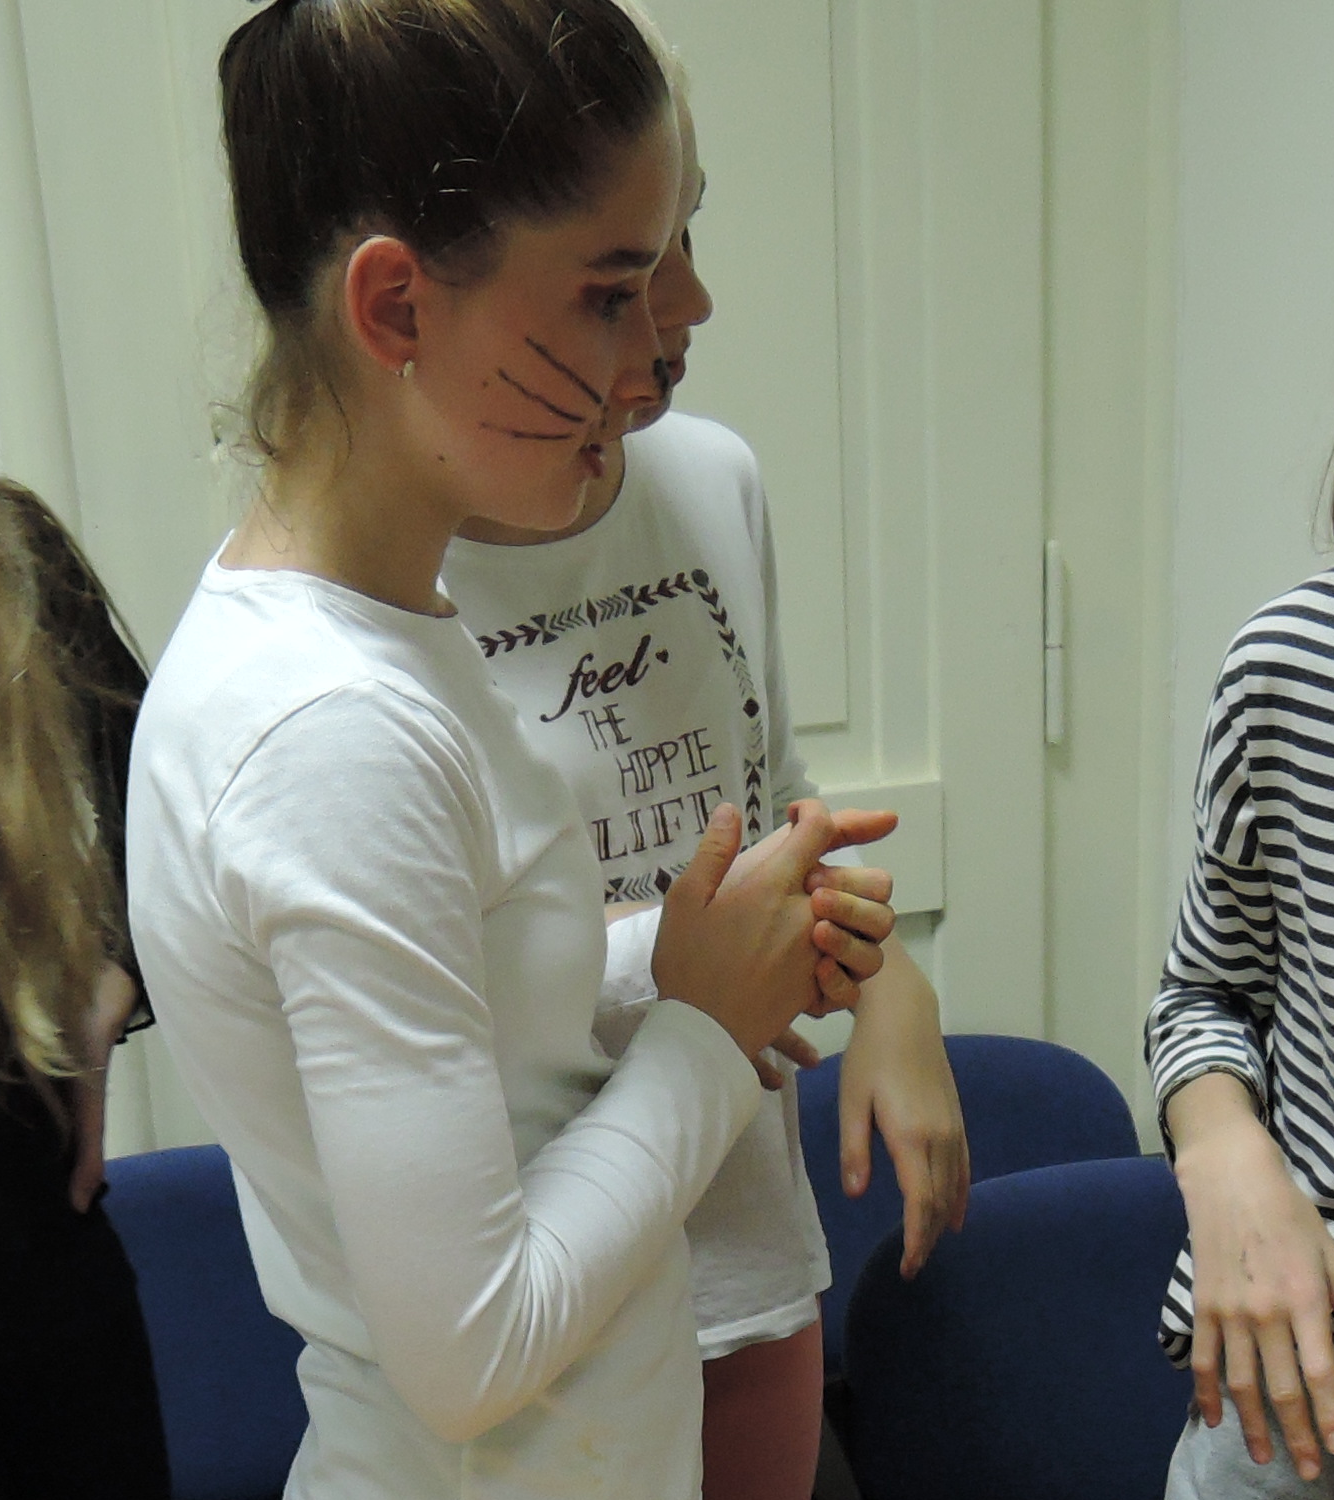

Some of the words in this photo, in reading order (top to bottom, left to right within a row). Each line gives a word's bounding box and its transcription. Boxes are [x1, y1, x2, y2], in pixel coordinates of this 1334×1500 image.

[540, 634, 652, 722] feel
[578, 703, 632, 751] THE
[616, 727, 717, 797] HIPPIE
